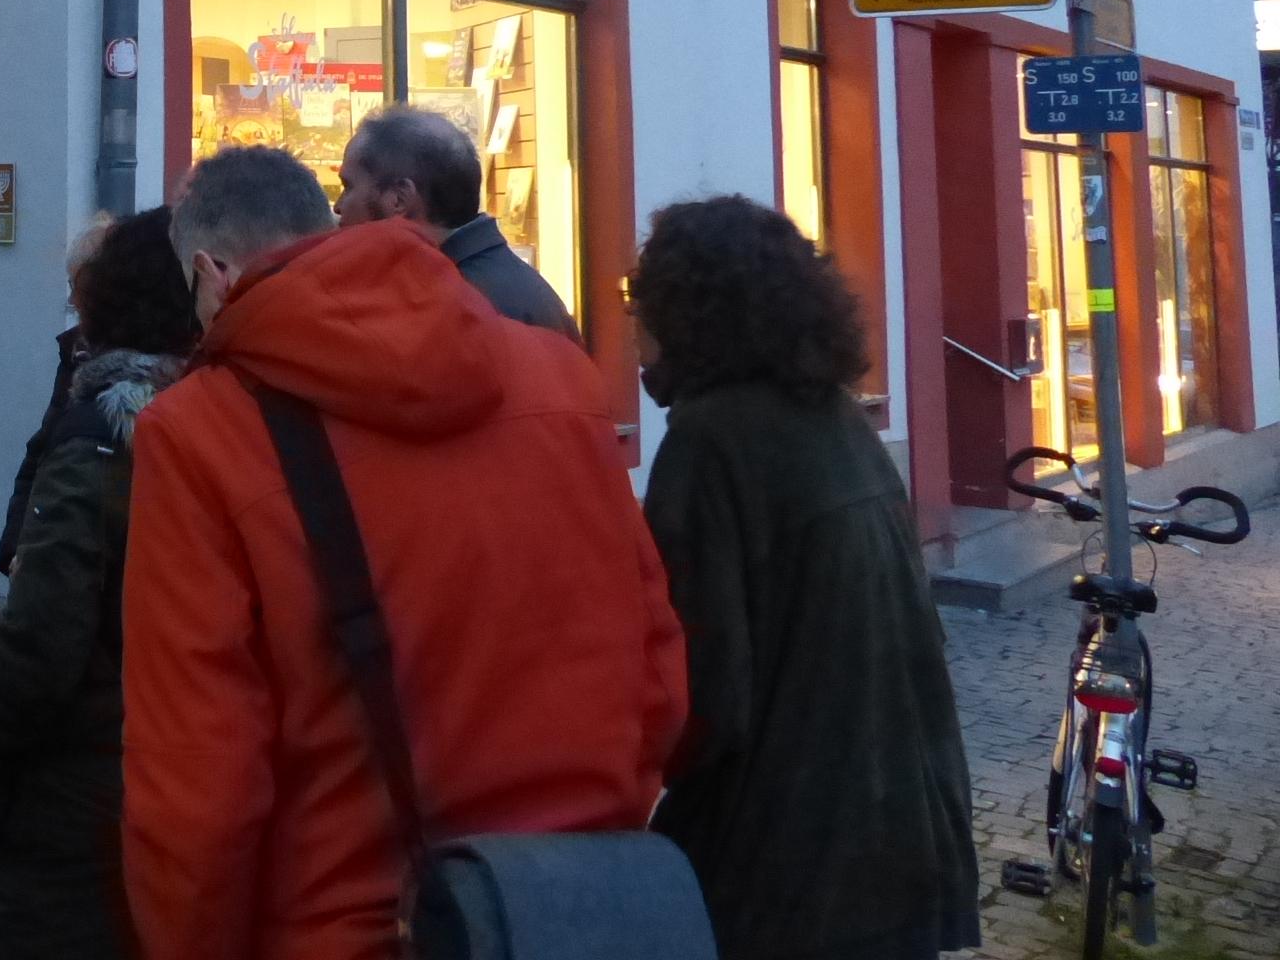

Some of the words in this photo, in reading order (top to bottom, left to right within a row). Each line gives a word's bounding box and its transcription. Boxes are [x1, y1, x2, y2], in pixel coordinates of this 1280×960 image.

[1025, 69, 1038, 85] S
[1057, 73, 1078, 84] 150
[1082, 66, 1096, 83] S
[1116, 71, 1138, 82] 100
